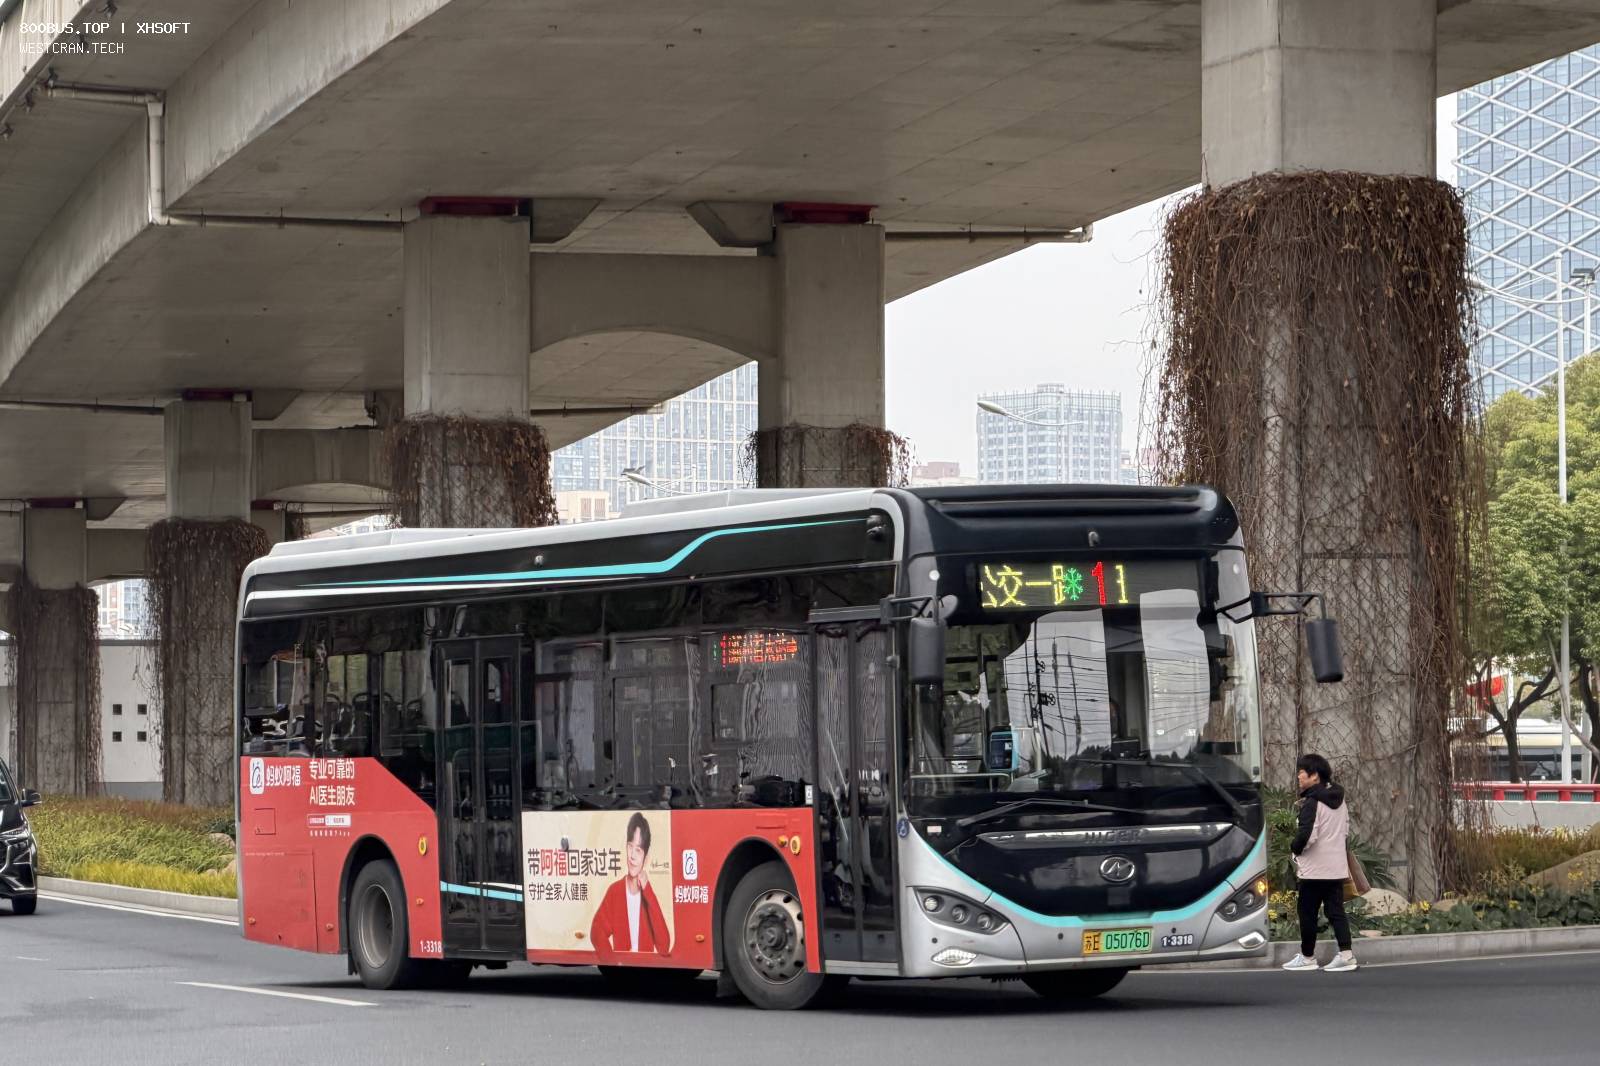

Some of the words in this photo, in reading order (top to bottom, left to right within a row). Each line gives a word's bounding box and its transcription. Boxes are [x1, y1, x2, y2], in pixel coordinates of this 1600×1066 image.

[265, 764, 302, 787] 蚂蚁阿福
[308, 757, 355, 780] 专业可靠的
[308, 785, 356, 806] AI医生朋友
[527, 848, 622, 877] 带阿福回家过年
[528, 882, 589, 901] 守护全家人健康
[674, 885, 709, 904] 蚂蚁阿福
[420, 939, 442, 953] 1-3318
